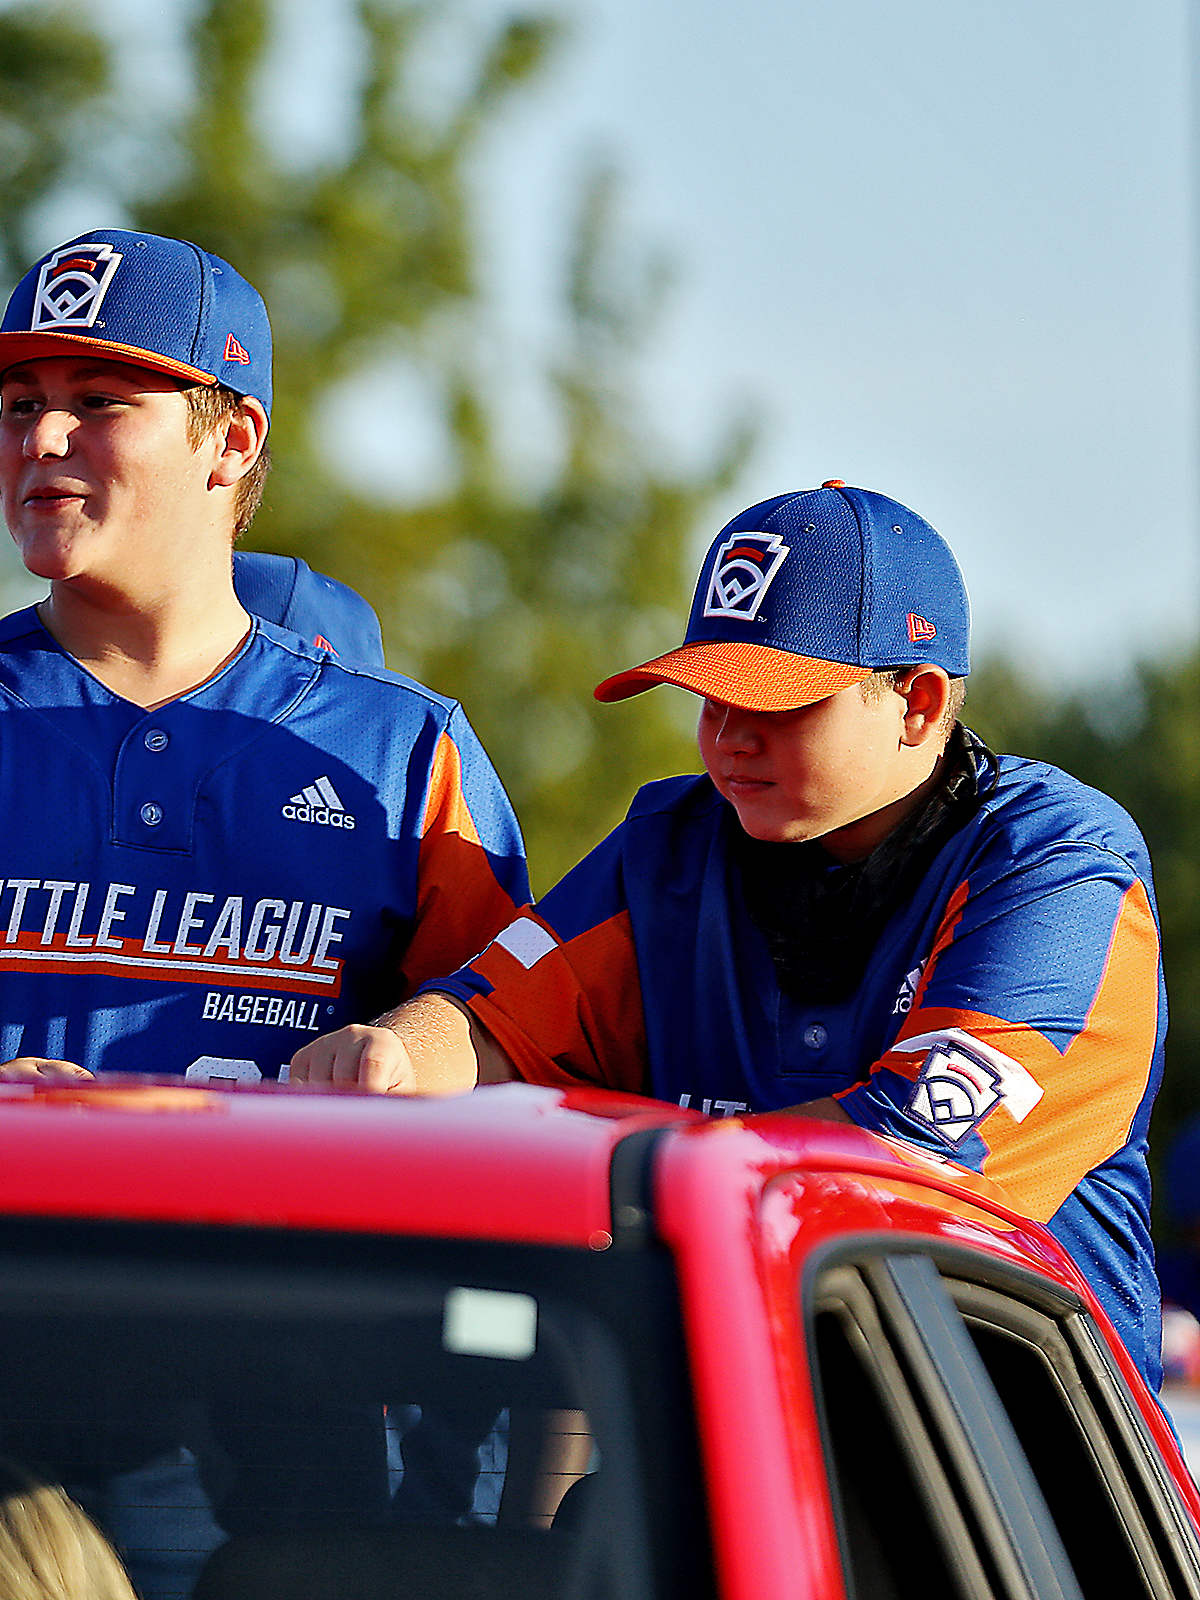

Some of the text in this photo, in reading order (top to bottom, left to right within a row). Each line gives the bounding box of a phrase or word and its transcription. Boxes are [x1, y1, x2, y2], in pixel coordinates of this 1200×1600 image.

[282, 804, 355, 830] adidas
[142, 889, 351, 970] LEAGUE
[202, 992, 320, 1031] BASEBALL
